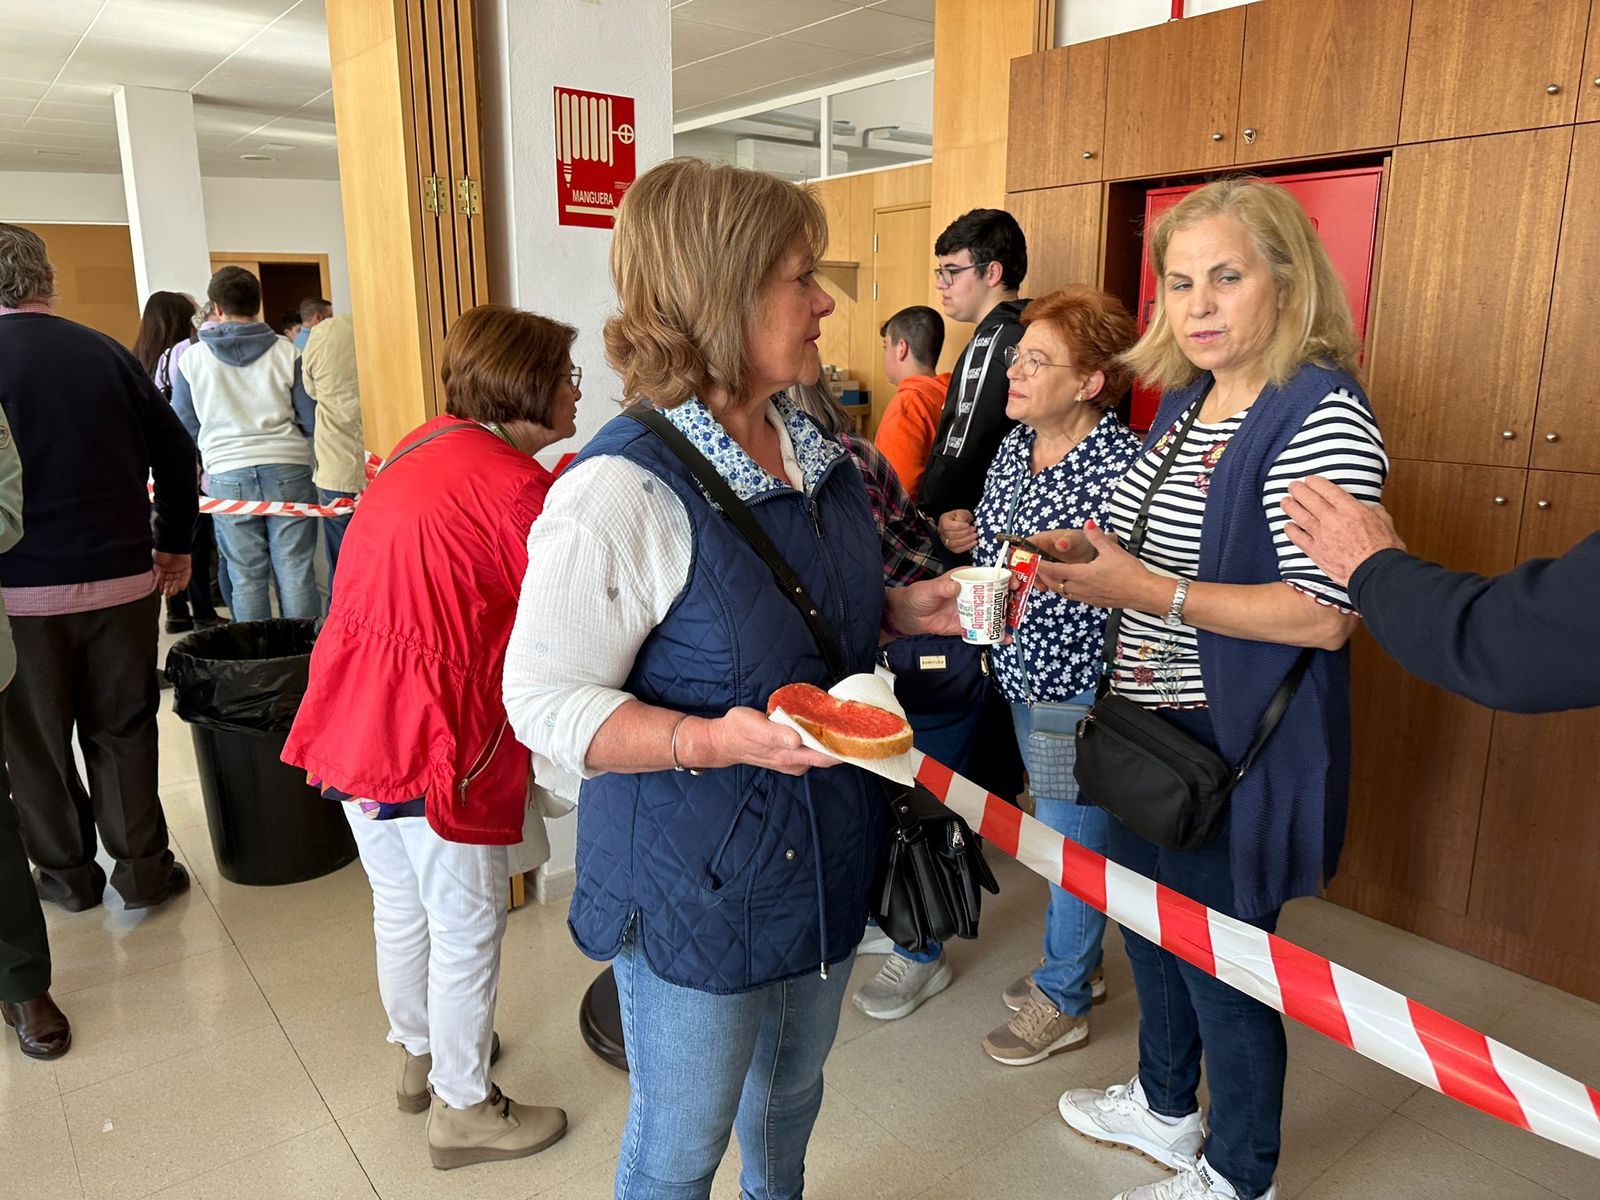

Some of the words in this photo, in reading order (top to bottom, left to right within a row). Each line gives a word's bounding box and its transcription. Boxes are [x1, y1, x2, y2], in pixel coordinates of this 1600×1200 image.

[572, 189, 614, 206] MANGUERA
[972, 584, 985, 630] Americano
[989, 592, 1004, 641] Cappuccino
